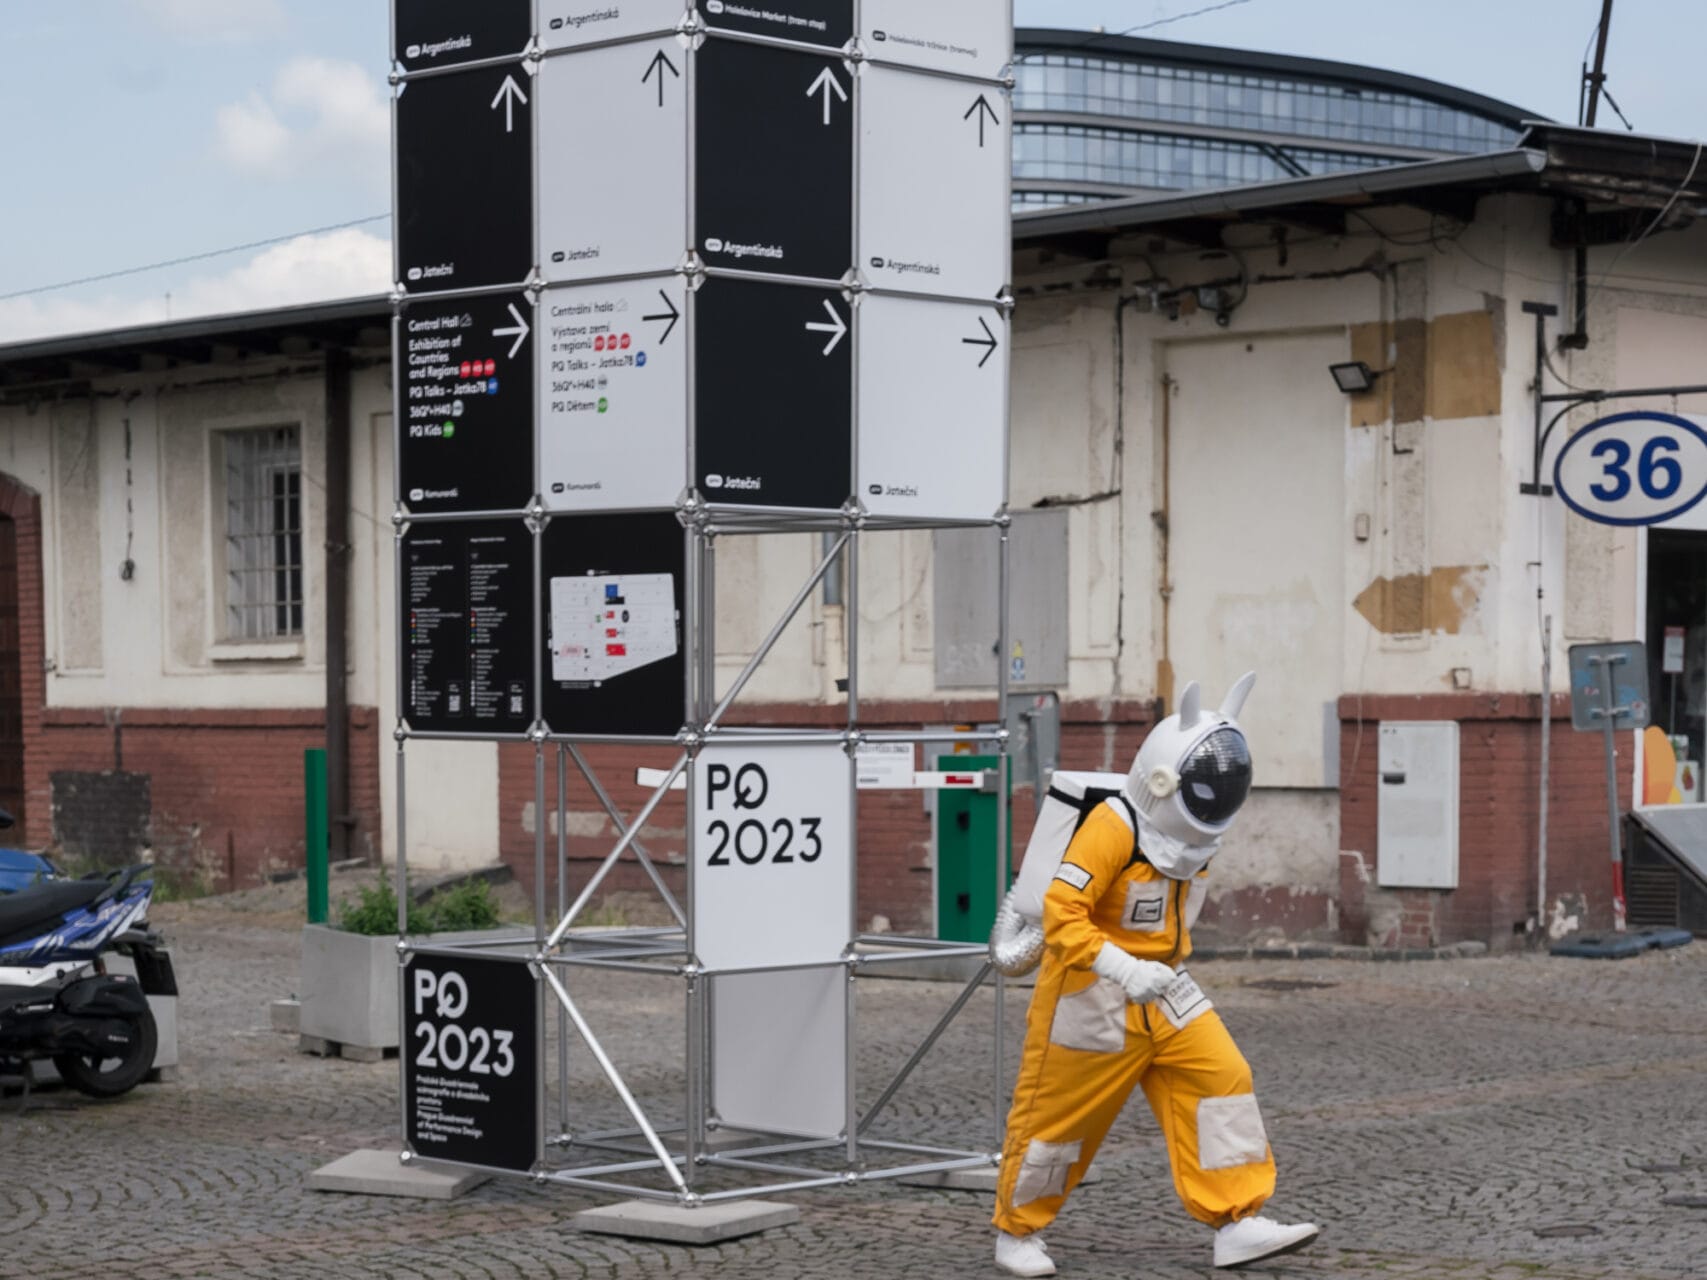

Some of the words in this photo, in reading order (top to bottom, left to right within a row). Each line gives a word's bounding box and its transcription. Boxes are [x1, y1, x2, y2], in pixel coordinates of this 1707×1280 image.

[565, 9, 619, 28] Argentinská
[421, 35, 472, 57] Argentinská
[724, 241, 783, 258] Argentinská
[887, 259, 940, 275] Argentinská
[408, 317, 439, 332] Central
[441, 315, 459, 329] Hall
[451, 334, 462, 348] of
[409, 351, 449, 365] Countries
[552, 361, 565, 372] PQ
[567, 359, 588, 371] Talks
[409, 367, 426, 379] and
[427, 364, 459, 380] Regions
[409, 385, 423, 398] PQ
[424, 384, 445, 397] Talks
[552, 401, 565, 412] PQ
[410, 424, 423, 437] PQ
[424, 423, 442, 437] Kids
[1590, 436, 1682, 502] 36
[724, 476, 761, 490] Jateční
[707, 762, 768, 810] PQ
[707, 817, 822, 866] 2023
[415, 969, 469, 1019] PQ
[415, 1021, 515, 1077] 2023
